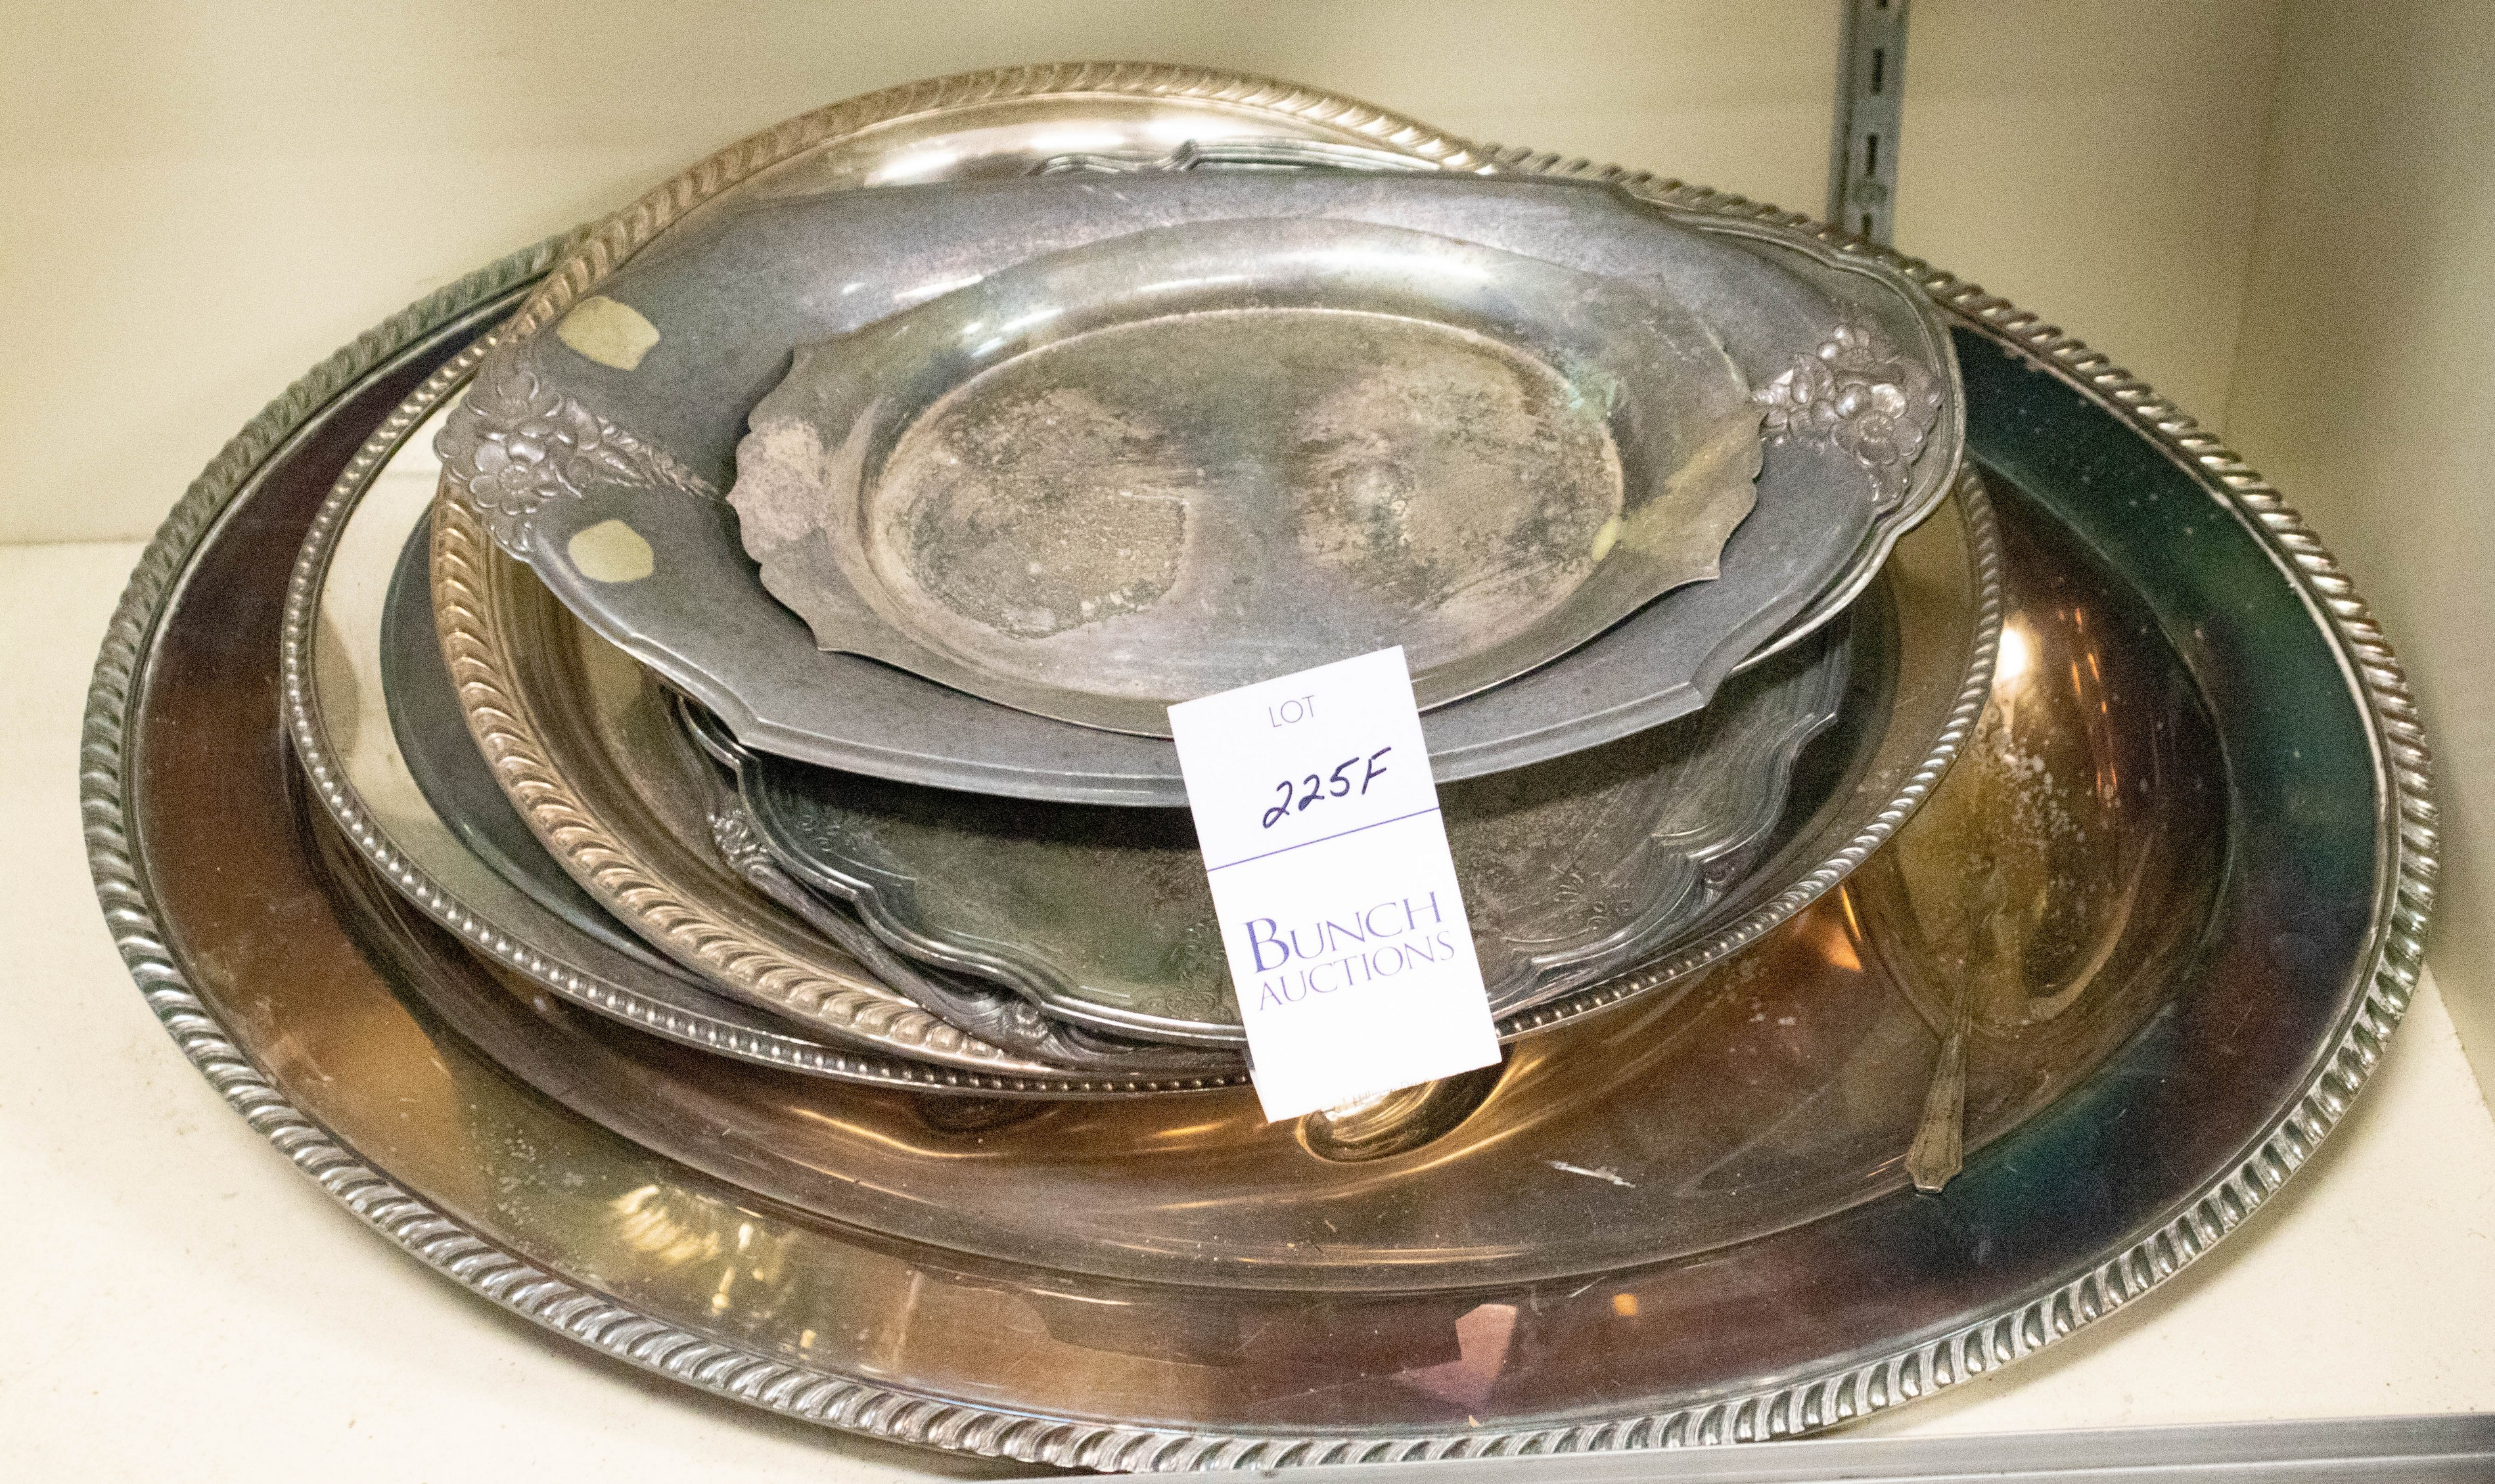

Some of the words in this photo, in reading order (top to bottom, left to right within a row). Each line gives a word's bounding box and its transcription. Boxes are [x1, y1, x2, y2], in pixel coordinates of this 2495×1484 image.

[1269, 695, 1315, 727] LOT
[1262, 746, 1392, 829] 225F
[1243, 891, 1442, 974] BUNCH
[1260, 931, 1455, 1010] AUCTIONS
